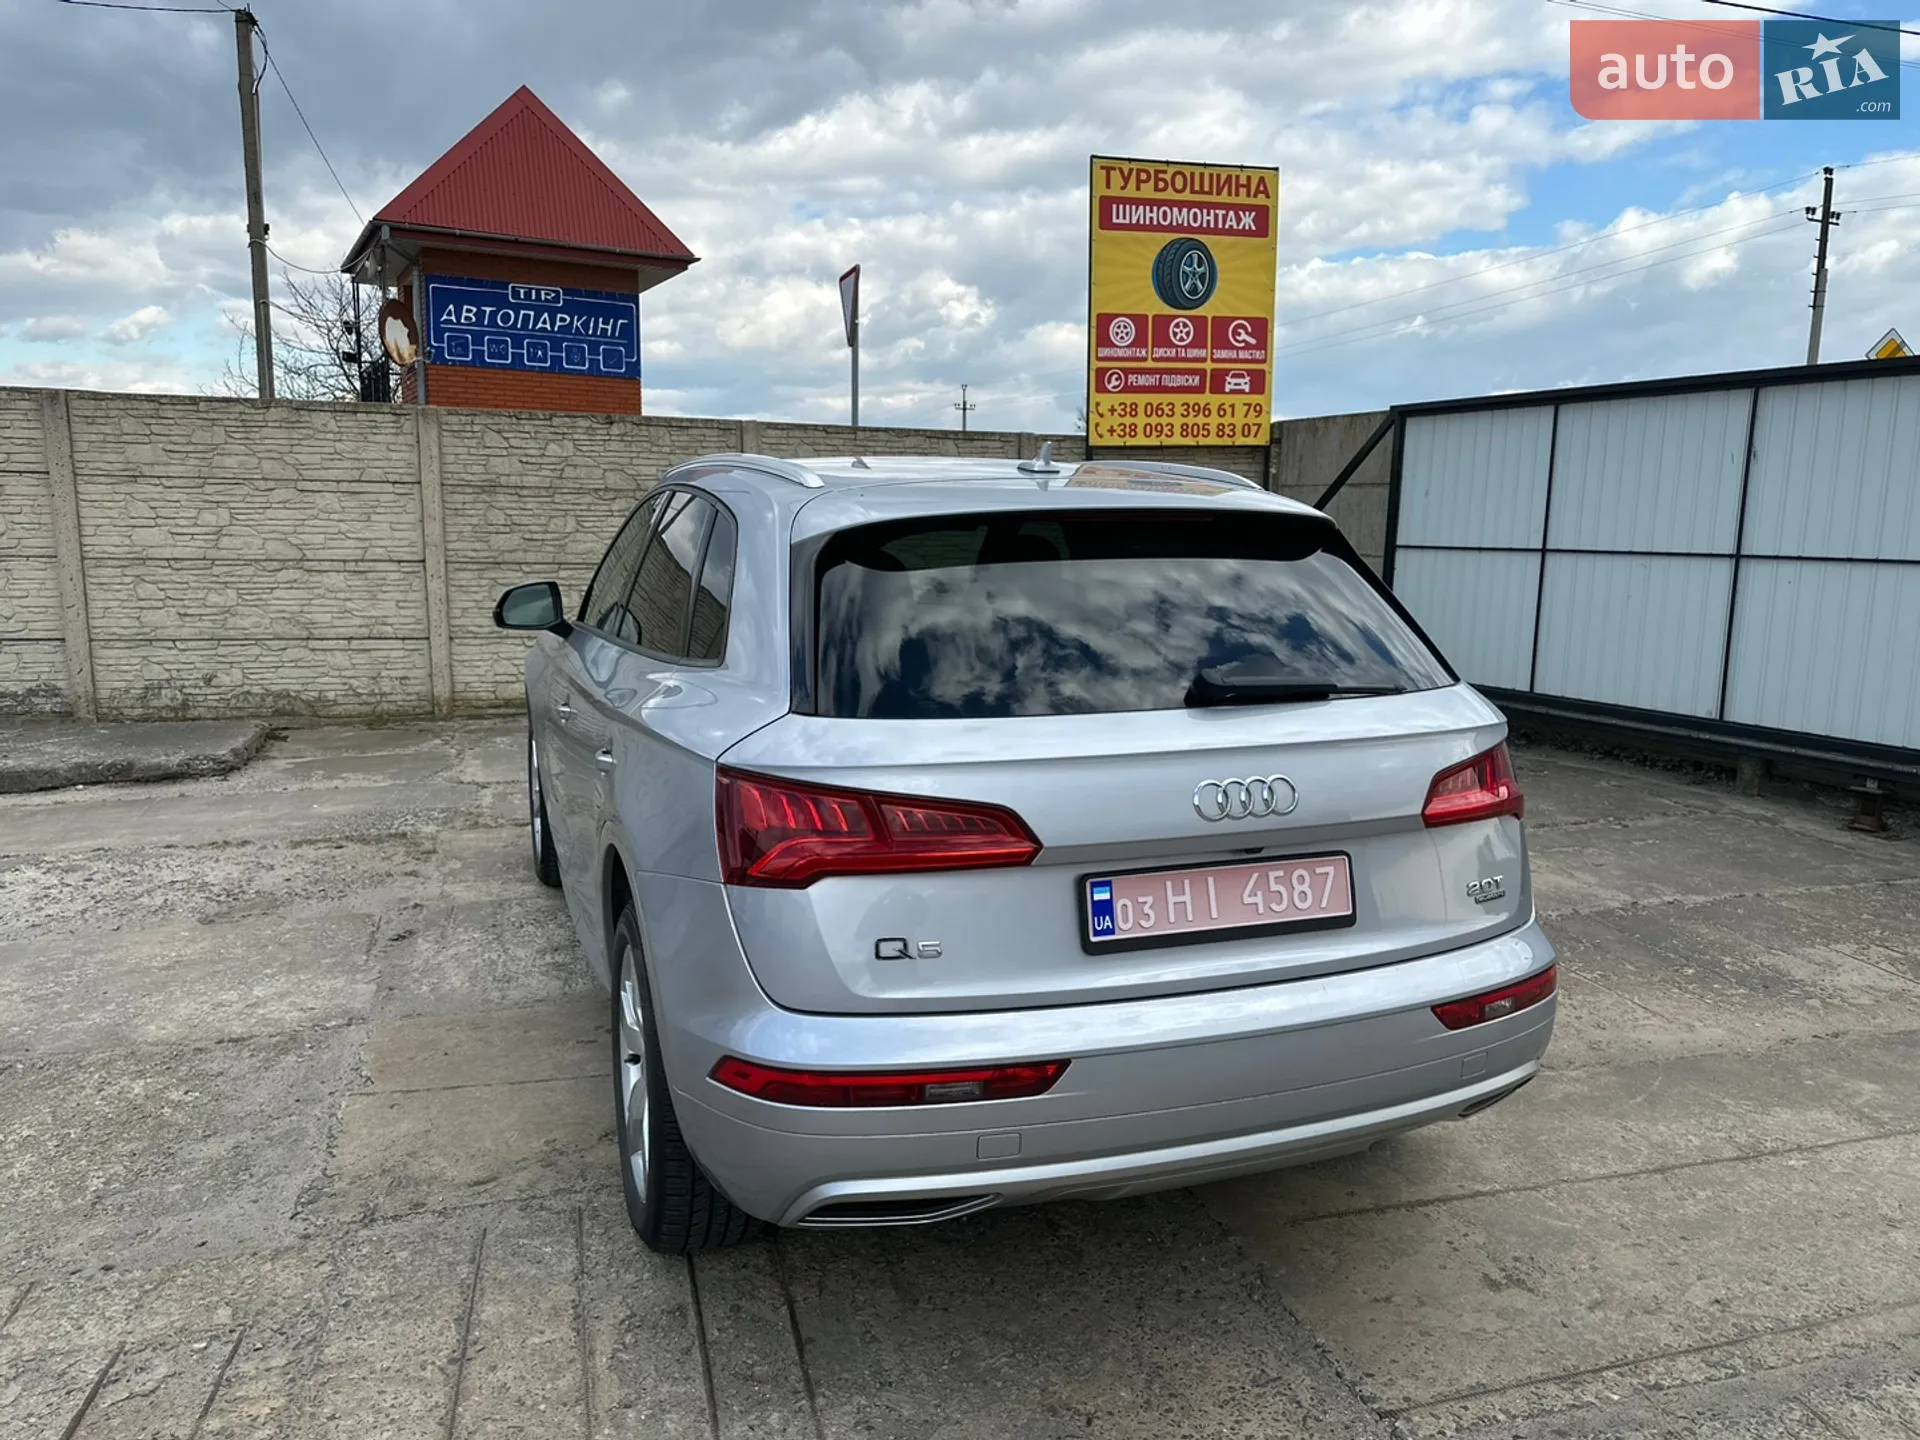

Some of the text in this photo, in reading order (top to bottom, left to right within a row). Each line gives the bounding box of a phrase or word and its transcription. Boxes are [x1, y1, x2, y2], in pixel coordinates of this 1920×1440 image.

[1100, 165, 1271, 199] ТУРБОШИНА
[1111, 203, 1256, 231] ШИНОМОНТАЖ
[514, 286, 557, 301] TIR
[440, 303, 629, 338] АВТОПАРКІНГ
[1097, 347, 1148, 358] ШИНОМОНТАЖ
[1152, 347, 1176, 359] ДИСКИ
[1177, 348, 1187, 358] ТА
[1128, 374, 1200, 388] РЕМОНТ ПІДВІСКИ
[1107, 402, 1263, 418] +38 063 396 61 79
[1106, 422, 1262, 438] +38 093 805 83 07
[1242, 866, 1336, 916] 4587
[1094, 916, 1113, 931] UA
[875, 937, 943, 960] Q5
